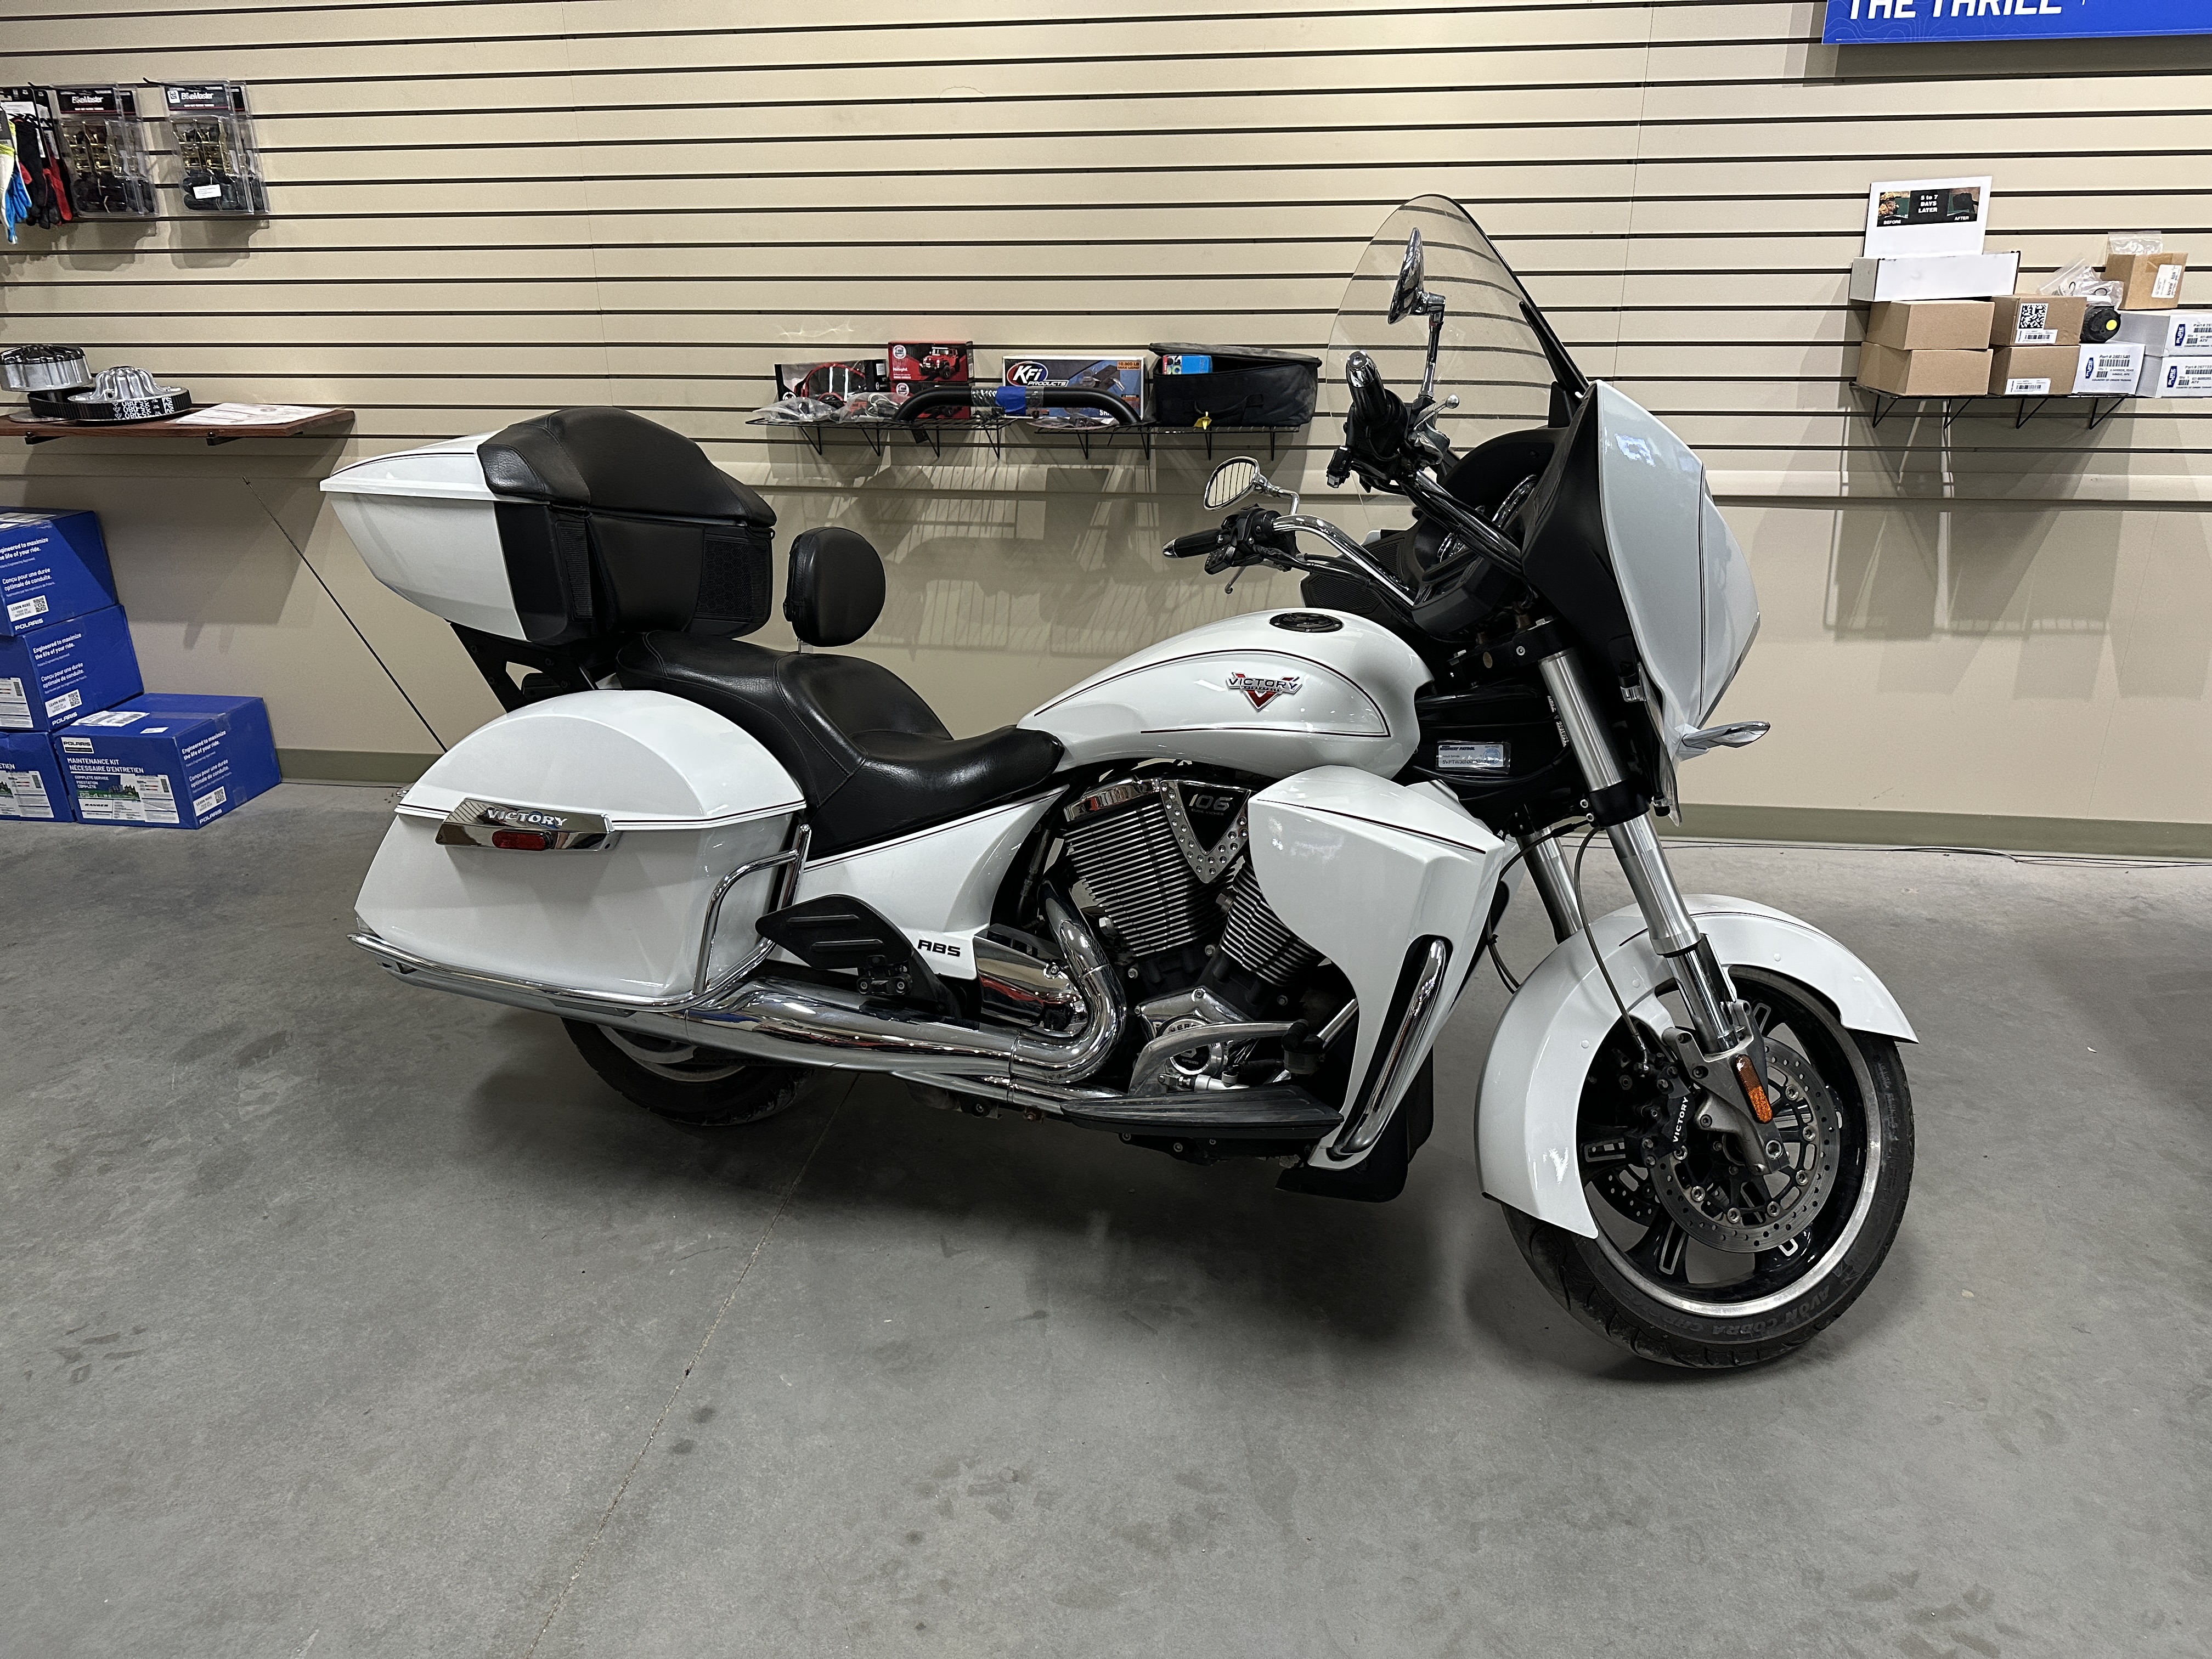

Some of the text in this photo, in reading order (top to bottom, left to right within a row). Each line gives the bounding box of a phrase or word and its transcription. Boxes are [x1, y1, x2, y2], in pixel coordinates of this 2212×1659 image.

[26, 538, 49, 547] maximize
[19, 549, 30, 557] your
[4, 582, 24, 591] optimale
[15, 618, 44, 630] POLARIS
[33, 641, 57, 653] Engineered
[55, 646, 65, 654] your
[1229, 678, 1298, 691] VICTORY
[52, 712, 78, 726] POLARIS
[182, 740, 204, 754] Engineered
[1189, 794, 1234, 811] 106
[199, 808, 222, 824] POLARIS
[487, 808, 568, 826] VICTORY
[917, 939, 961, 957] ABS
[1672, 1097, 1689, 1142] VICTORY
[1785, 1286, 1830, 1324] AVON
[1712, 1318, 1778, 1335] COBRA
